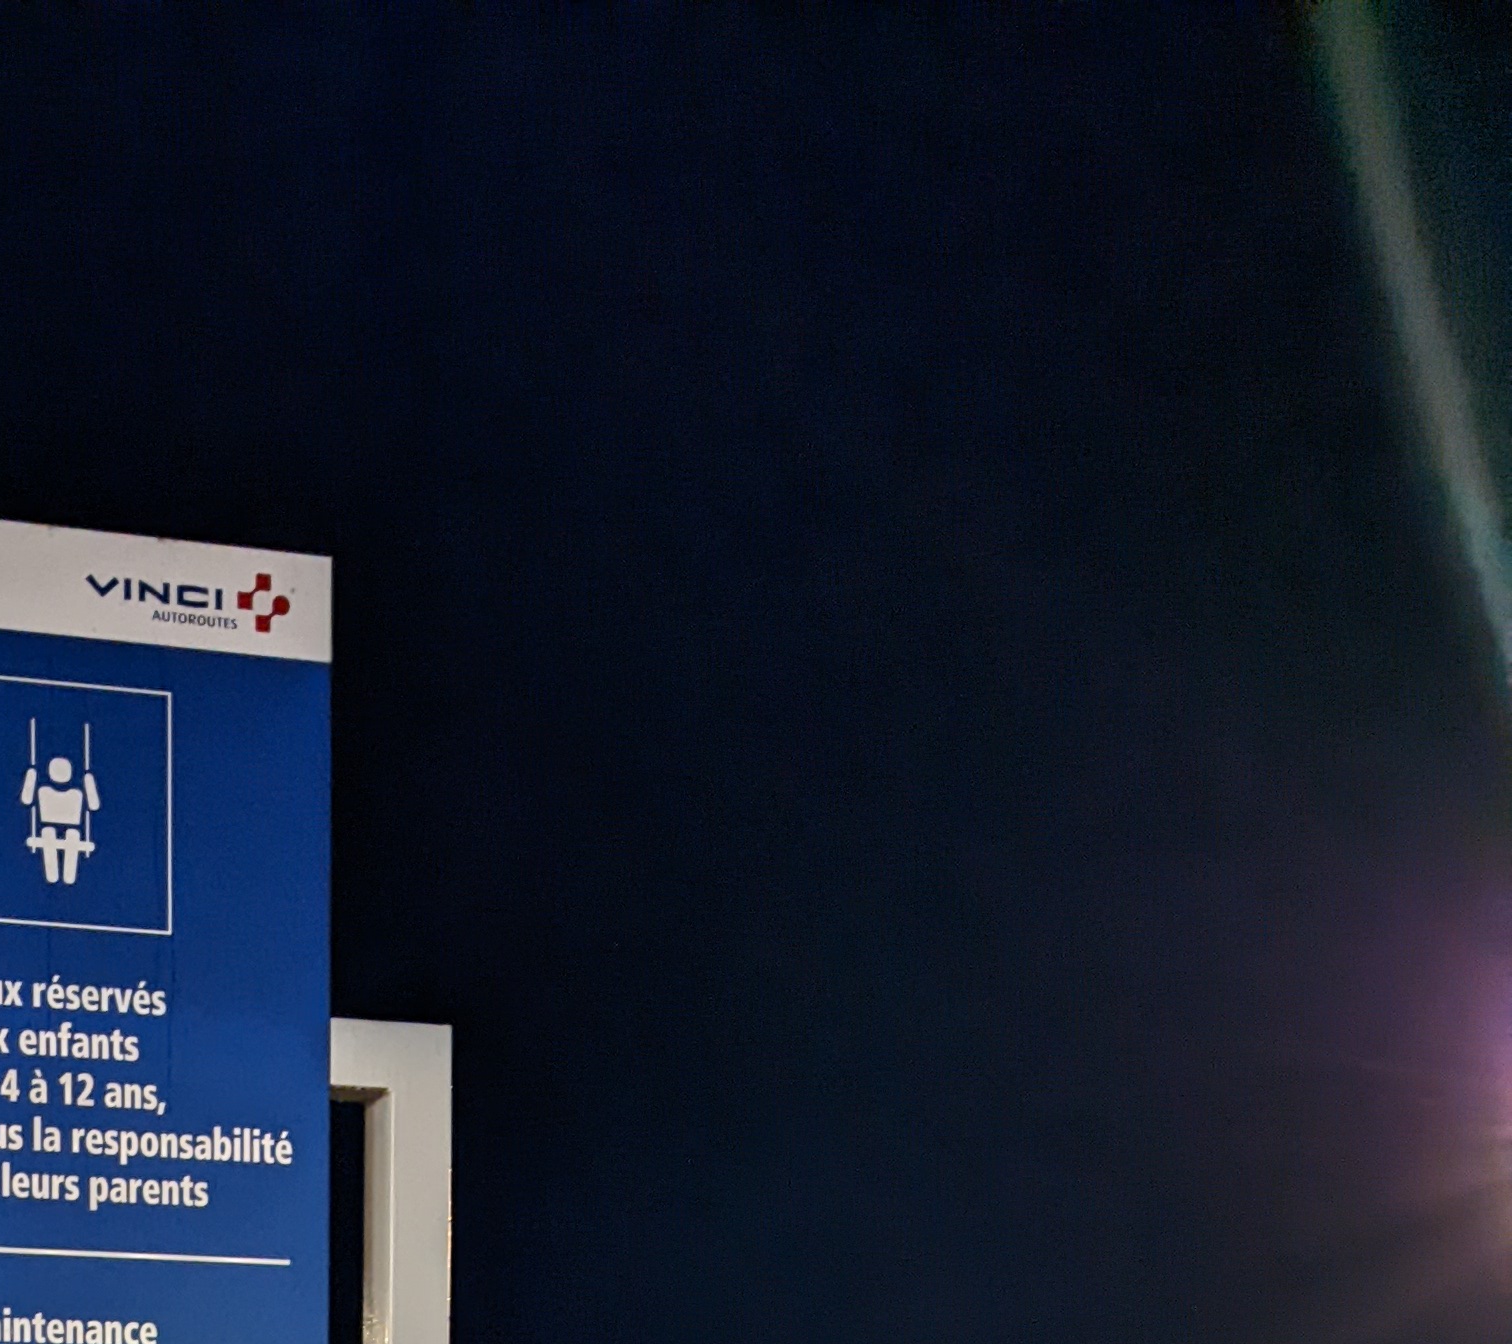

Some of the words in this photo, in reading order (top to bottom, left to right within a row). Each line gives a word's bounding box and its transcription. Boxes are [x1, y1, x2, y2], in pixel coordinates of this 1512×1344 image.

[85, 573, 223, 611] VINCI
[151, 609, 238, 630] AUTOROUTES
[31, 974, 167, 1017] réservés
[19, 1021, 140, 1062] enfants
[0, 1068, 20, 1103] 4
[29, 1069, 48, 1104] à
[57, 1071, 95, 1107] 12
[104, 1080, 167, 1116] ans,
[32, 1117, 61, 1153] la
[72, 1125, 293, 1166] responsabilité
[1, 1163, 80, 1201] leurs
[89, 1173, 209, 1212] parents
